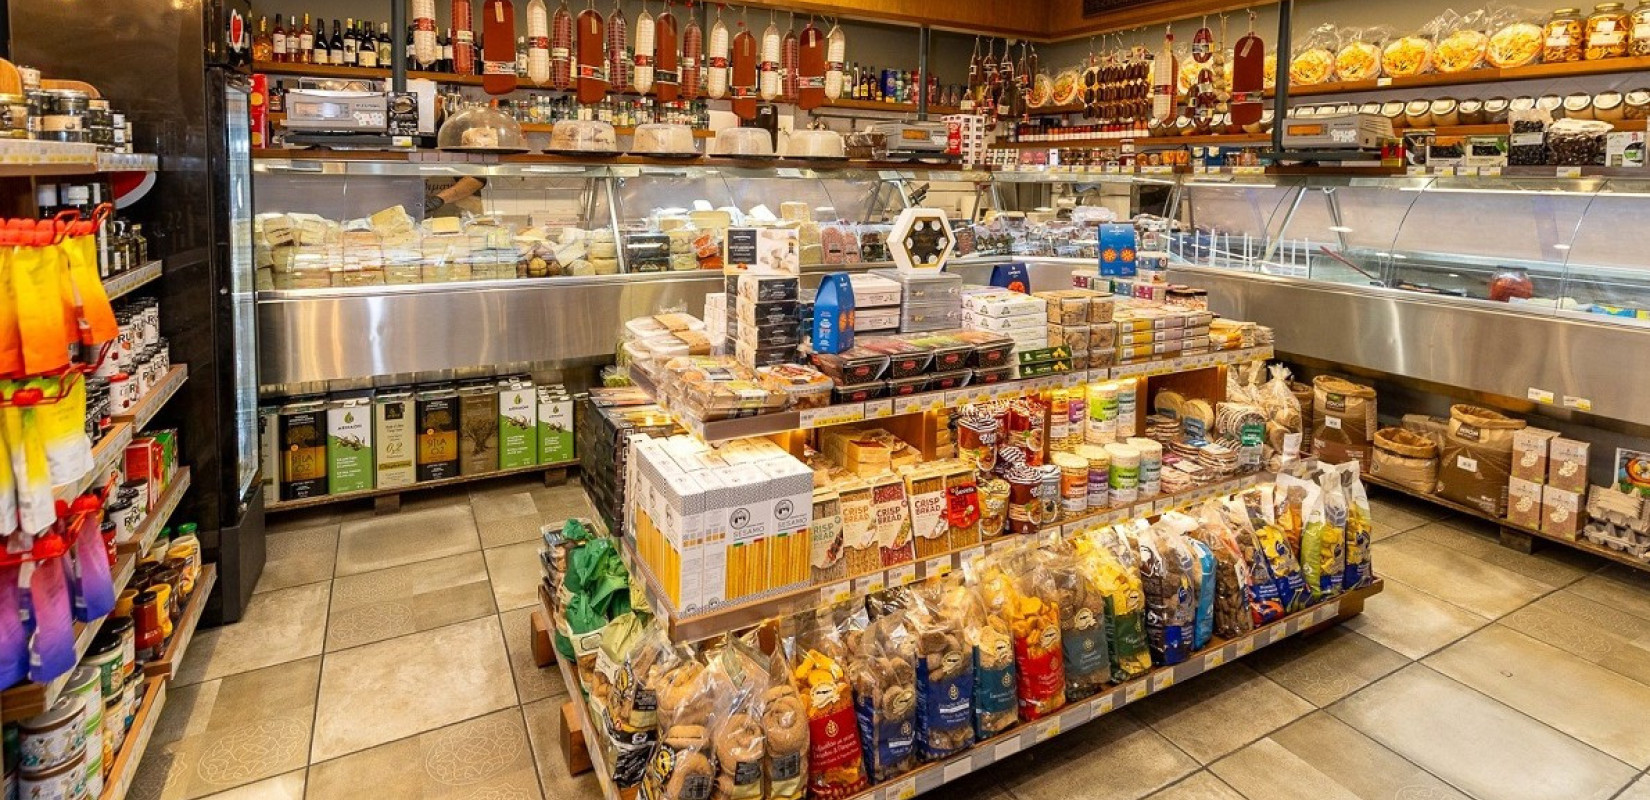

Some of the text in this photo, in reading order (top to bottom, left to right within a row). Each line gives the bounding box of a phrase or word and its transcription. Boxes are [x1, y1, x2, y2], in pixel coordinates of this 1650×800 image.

[914, 497, 940, 508] CRISP
[843, 506, 869, 517] CRISP
[876, 506, 901, 518] CRISP
[915, 505, 941, 516] BREAD
[778, 516, 808, 529] SESAMO
[843, 514, 870, 524] BREAD
[877, 515, 902, 525] BREAD
[733, 526, 765, 538] SESAMO
[813, 523, 834, 535] RISP
